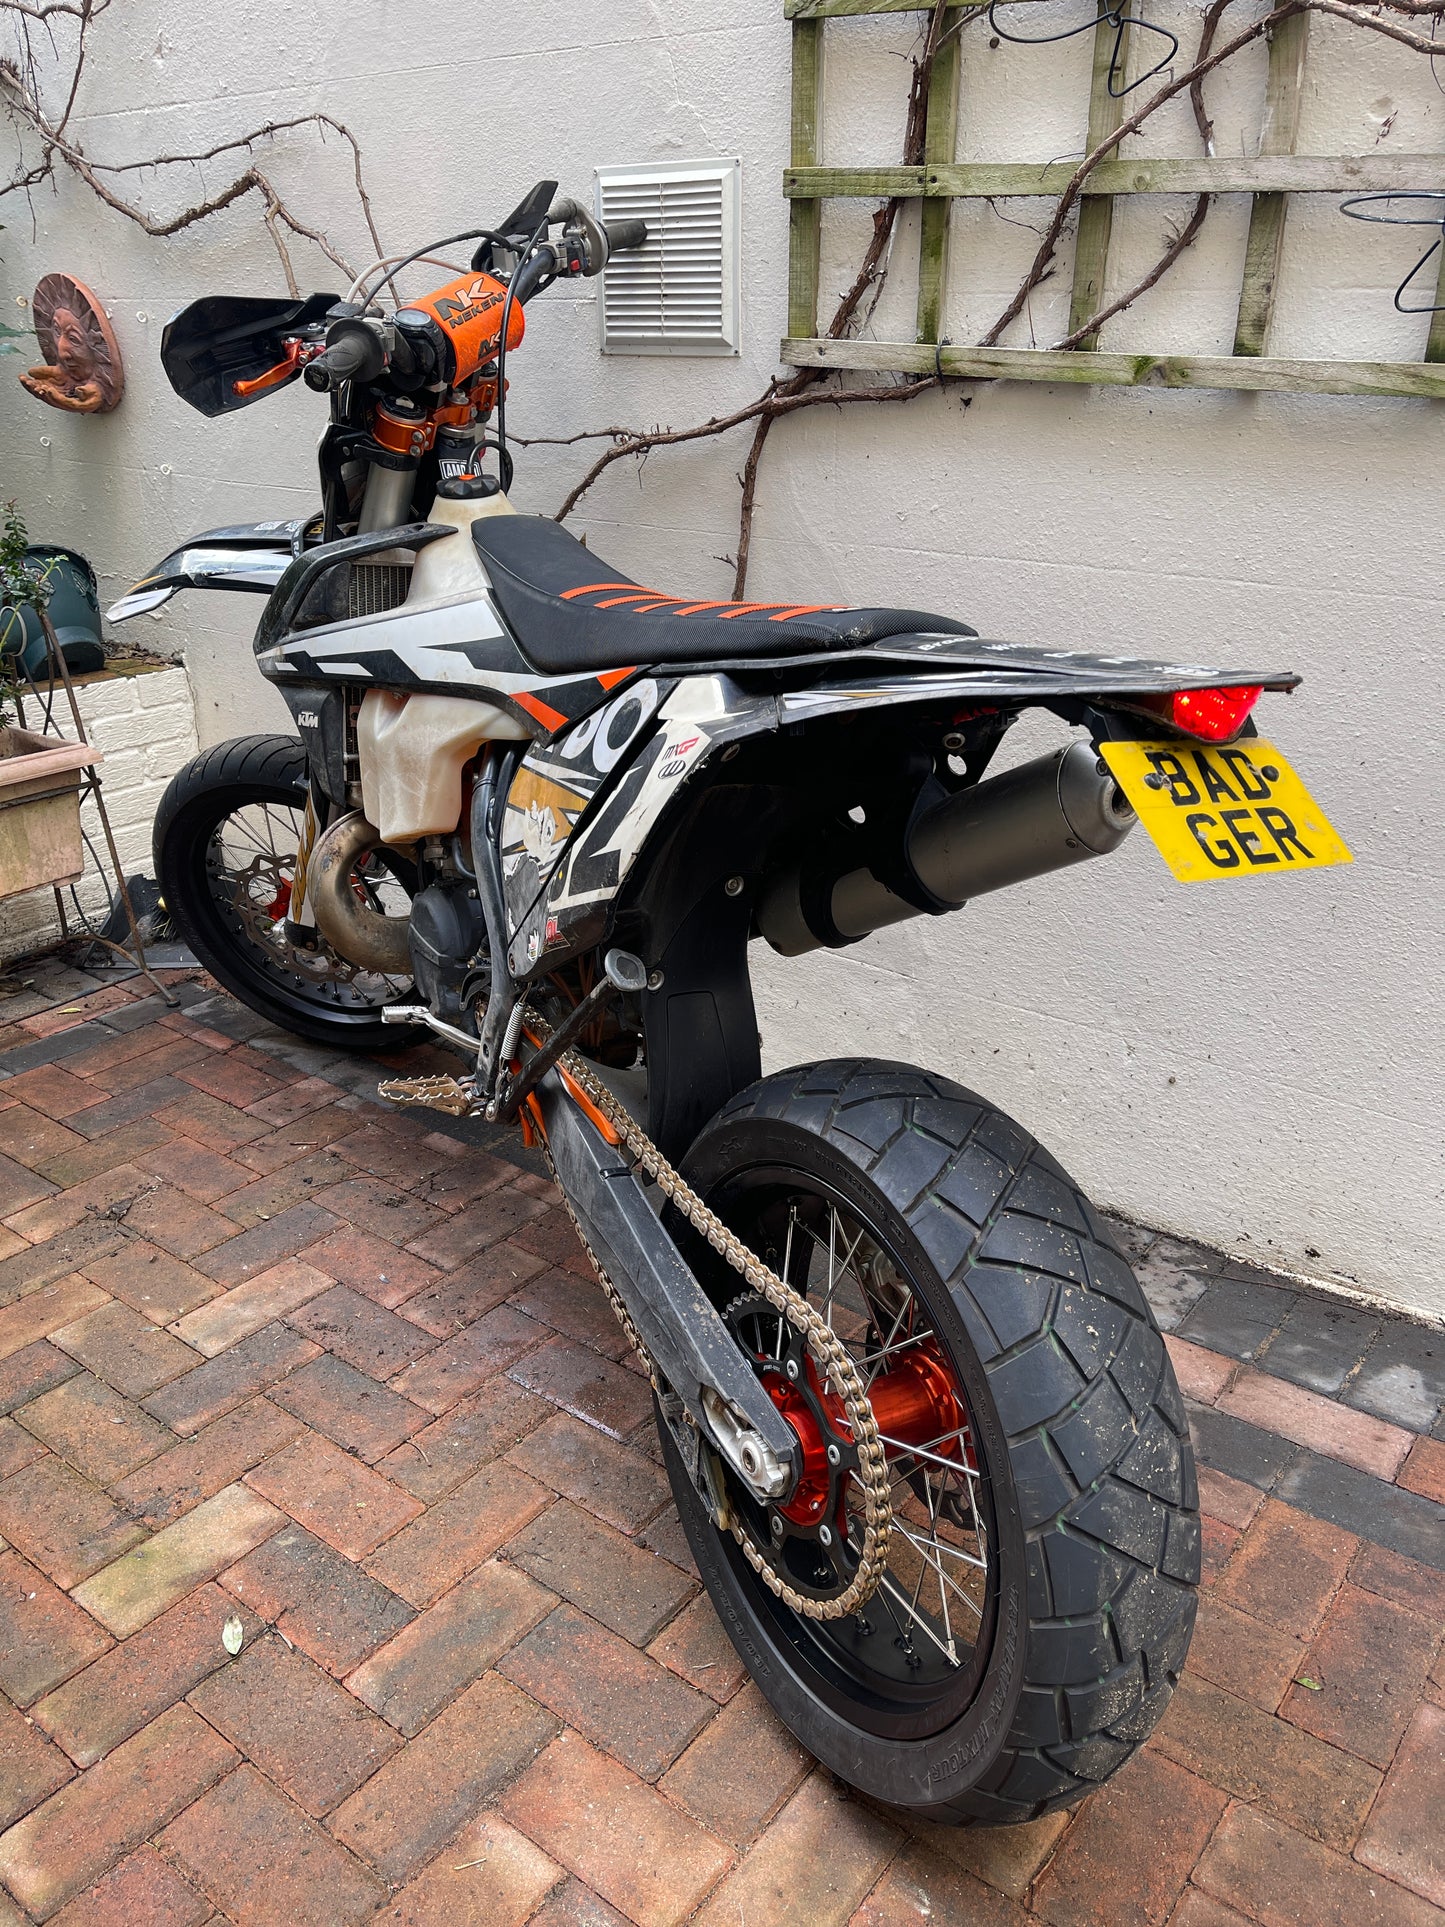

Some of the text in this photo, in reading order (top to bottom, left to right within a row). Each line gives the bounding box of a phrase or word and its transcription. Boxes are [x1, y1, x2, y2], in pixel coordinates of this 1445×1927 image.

[433, 277, 494, 321] NK
[448, 291, 504, 329] NEKEN
[297, 711, 319, 728] KTM
[1144, 750, 1272, 807] BAD
[1186, 806, 1316, 868] GER
[928, 1721, 990, 1783] MIXTOUR
